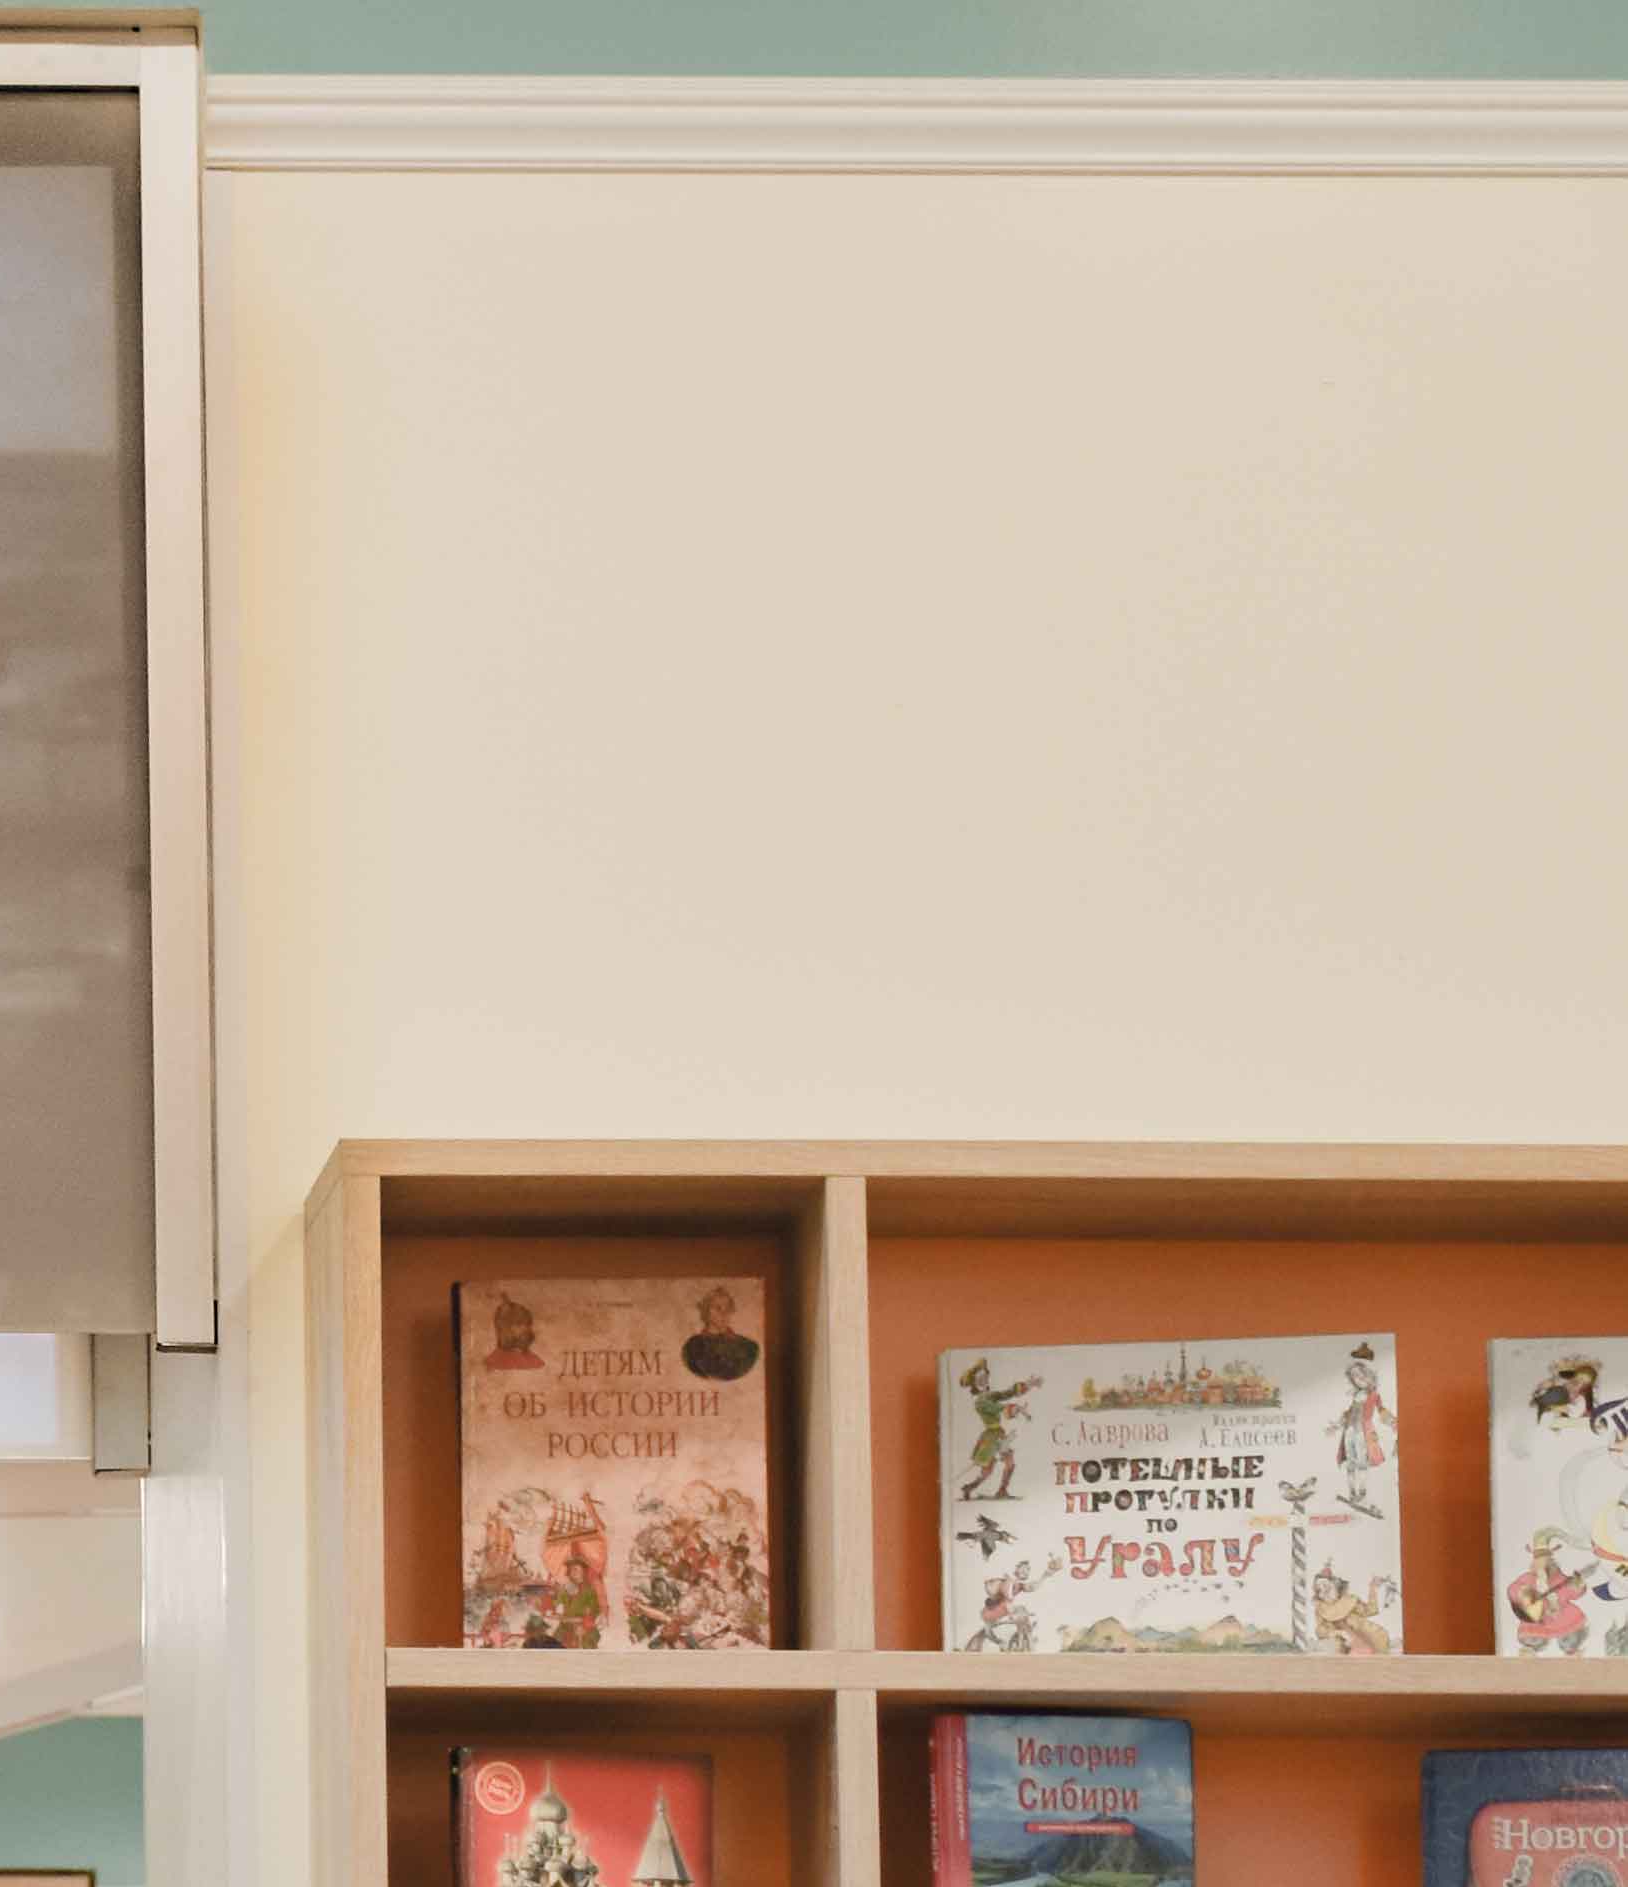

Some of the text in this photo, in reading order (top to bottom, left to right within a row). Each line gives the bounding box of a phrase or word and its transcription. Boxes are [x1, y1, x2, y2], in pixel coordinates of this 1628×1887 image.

[557, 1348, 662, 1380] ДЕТЯМ
[502, 1388, 721, 1419] ОБ ИСТОРИИ
[546, 1429, 679, 1461] РОССИИ
[1076, 1420, 1170, 1449] Лаврова
[1017, 1737, 1138, 1772] История
[1017, 1776, 1141, 1815] Сибири
